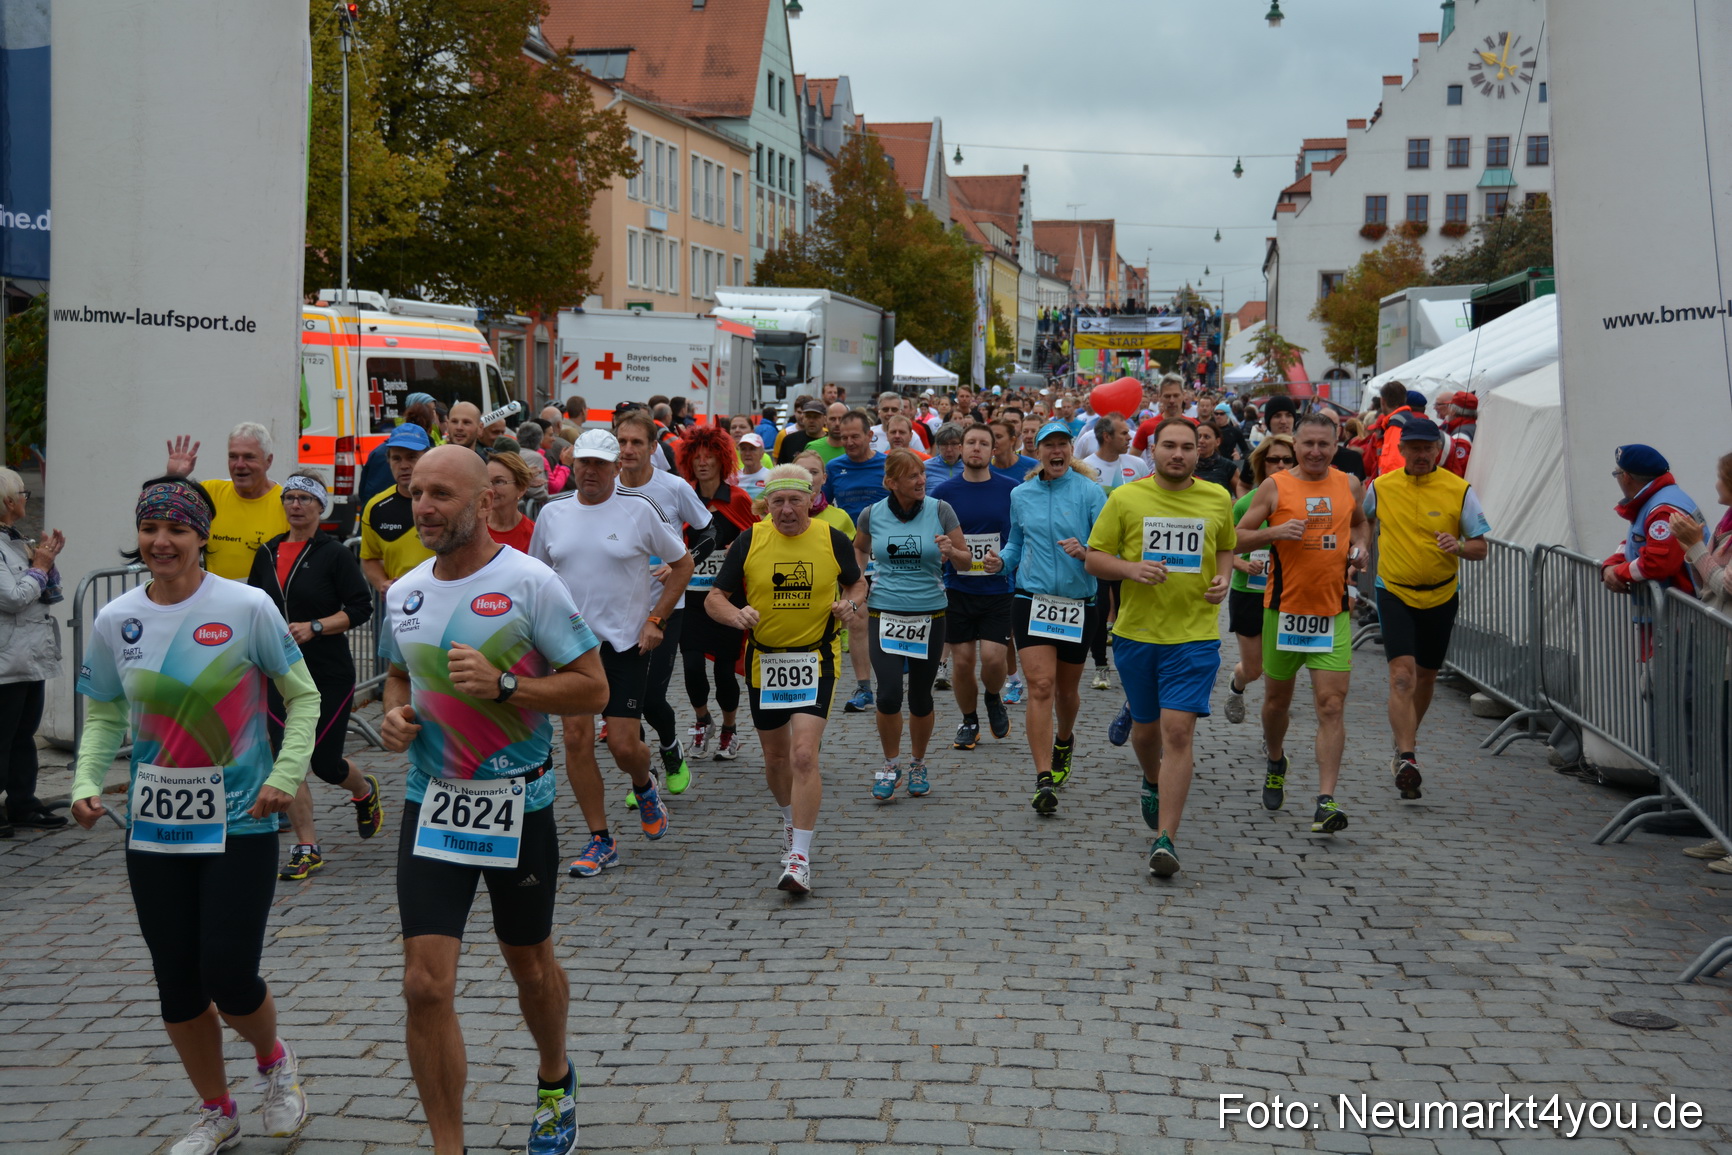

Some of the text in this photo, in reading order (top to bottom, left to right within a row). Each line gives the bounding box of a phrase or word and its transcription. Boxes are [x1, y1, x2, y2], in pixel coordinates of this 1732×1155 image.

[54, 306, 256, 333] www.bmw-laufsport.de
[1108, 338, 1145, 347] START
[627, 353, 677, 363] Bayerisches
[626, 364, 650, 372] Rotes
[626, 374, 650, 382] Kreuz
[212, 534, 241, 543] Norbert
[1149, 530, 1198, 552] 2110
[773, 592, 811, 600] HIRSCH
[476, 599, 507, 611] Hervis
[1036, 604, 1080, 625] 2612
[1047, 625, 1065, 634] Petra
[1284, 614, 1330, 634] 3090
[199, 628, 228, 640] Hervis
[885, 622, 926, 641] 2264
[898, 643, 909, 651] Pia
[1287, 635, 1312, 646] KURT
[123, 647, 143, 656] PARTL
[766, 665, 813, 688] 2693
[772, 692, 807, 703] Wolfgang
[490, 755, 514, 770] 16.
[138, 771, 206, 785] PARTL Neumarkt
[430, 777, 508, 796] PARTL Neumarkt
[140, 785, 216, 820] 2623
[431, 791, 514, 832] 2624
[157, 827, 194, 841] Katrin
[442, 834, 494, 853] Thomas
